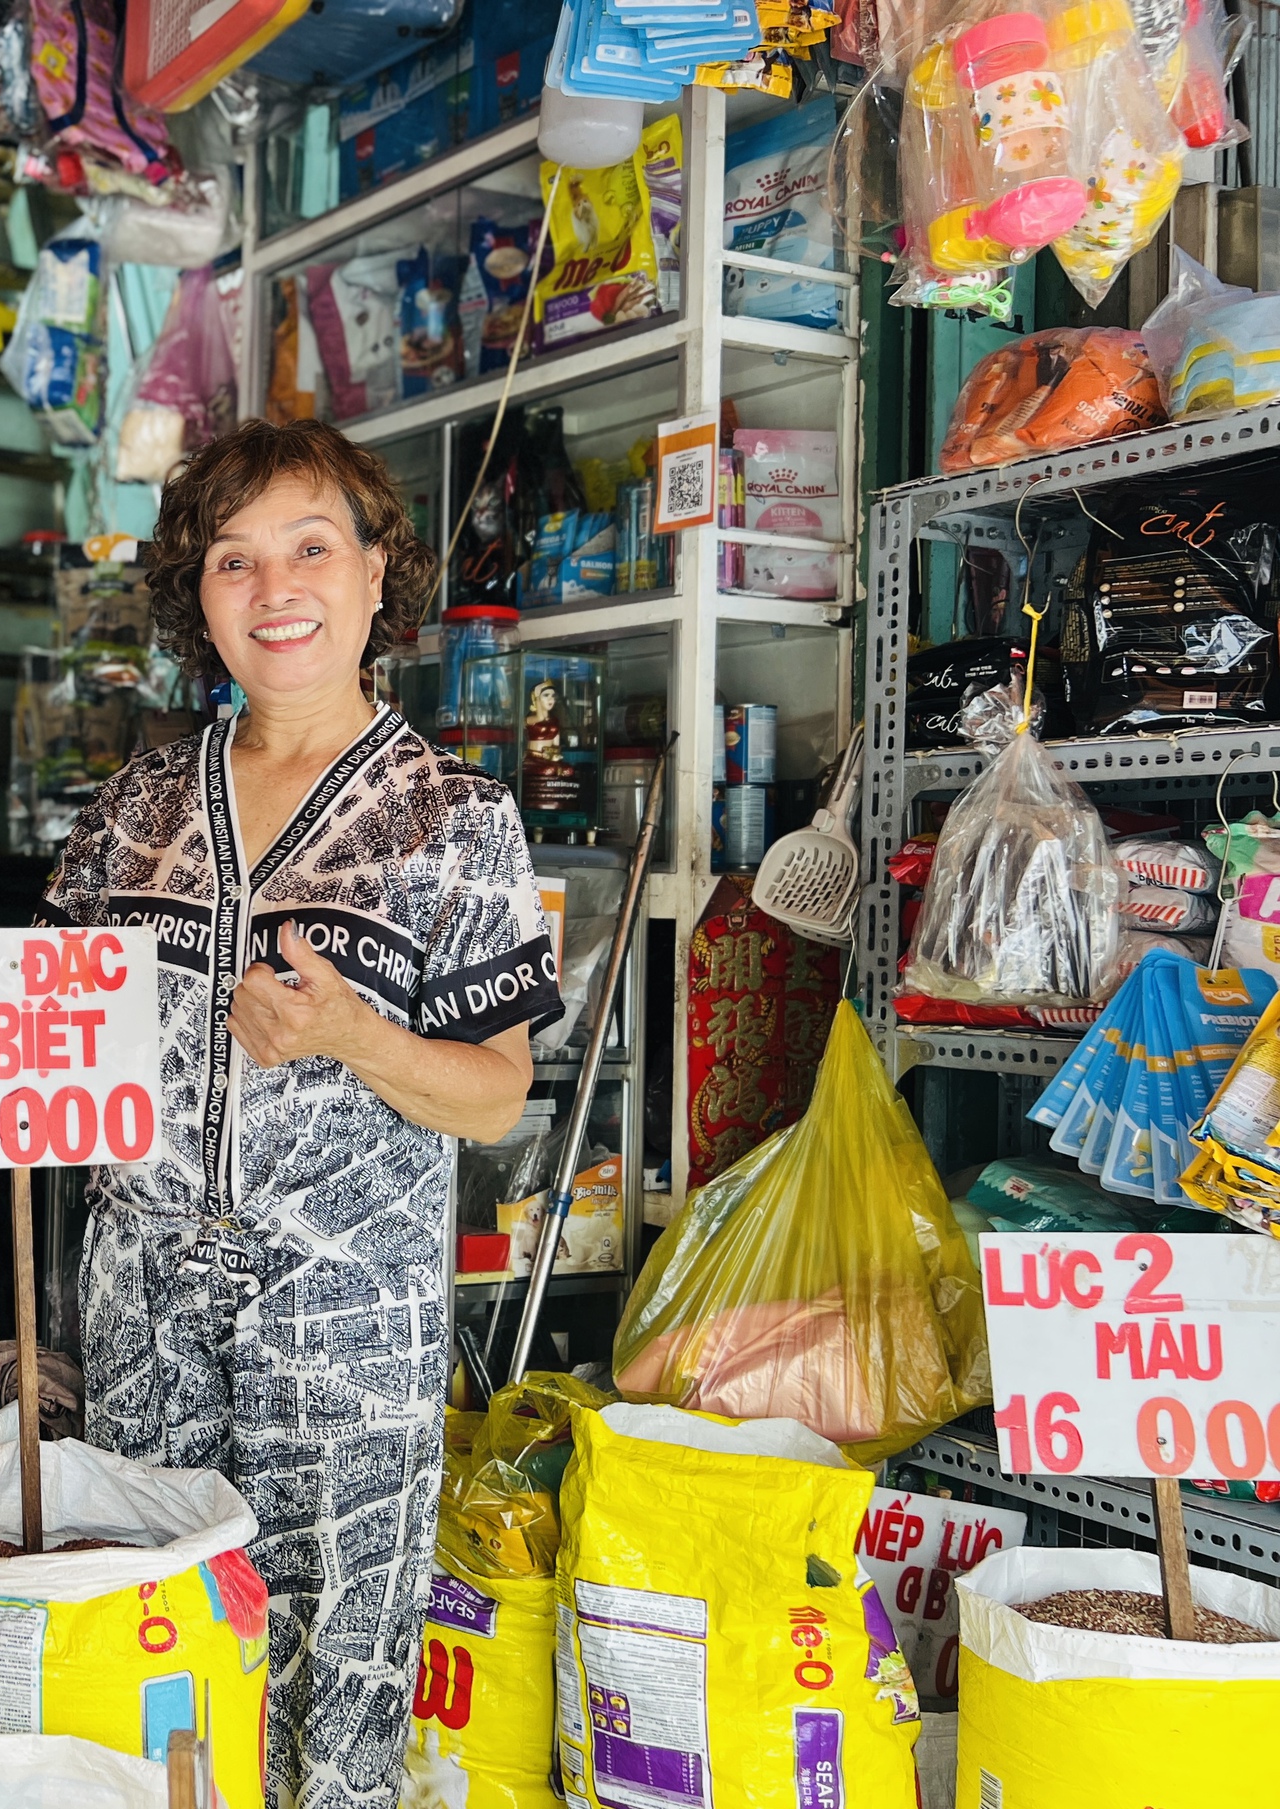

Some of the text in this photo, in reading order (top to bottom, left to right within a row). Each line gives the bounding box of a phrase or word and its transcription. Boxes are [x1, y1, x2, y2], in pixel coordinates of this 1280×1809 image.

[725, 173, 819, 214] ROYAL CANIN
[747, 483, 824, 496] ROYAL CANIN
[771, 507, 806, 516] KITTEN
[581, 560, 612, 570] SALMON
[208, 772, 222, 806] DIOR
[284, 820, 311, 851] DIOR
[305, 763, 354, 819] CHRISTIAN
[347, 741, 372, 770] DIOR
[211, 805, 231, 862] CHRISTIAN
[219, 862, 236, 899] DIOR
[218, 898, 234, 968] CHRISTIAN
[20, 929, 128, 998] ĐẶC
[465, 963, 539, 1015] DIOR
[214, 1003, 229, 1077] CHRISTIA
[207, 1085, 225, 1124] DIOR
[245, 1089, 363, 1127] AVENUE DE
[984, 1233, 1184, 1315] LỨC 2
[313, 1375, 368, 1401] MESSINE
[285, 1422, 368, 1441] HAUSSMANN
[995, 1391, 1280, 1481] 16 00
[856, 1492, 923, 1562] NẾP
[162, 1590, 171, 1613] FOOD
[368, 1664, 389, 1672] PLACE
[826, 1641, 834, 1661] FOOD
